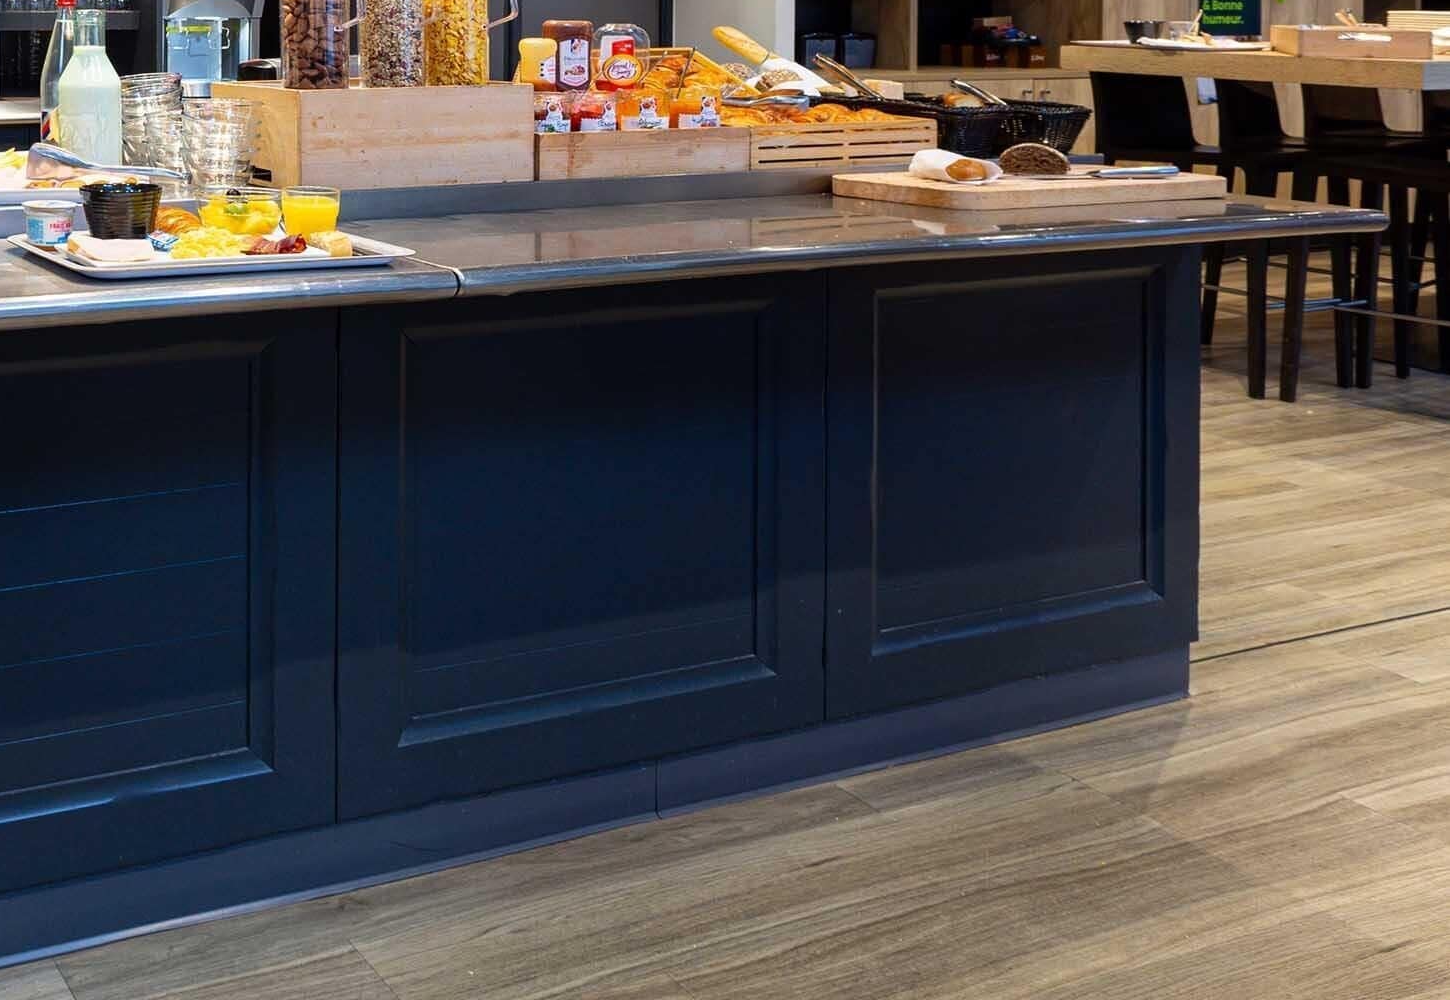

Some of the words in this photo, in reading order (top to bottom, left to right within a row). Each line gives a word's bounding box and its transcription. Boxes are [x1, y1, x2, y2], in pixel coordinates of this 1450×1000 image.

[1202, 1, 1210, 11] &
[1212, 1, 1244, 11] Bonne
[1202, 13, 1245, 25] humeur.
